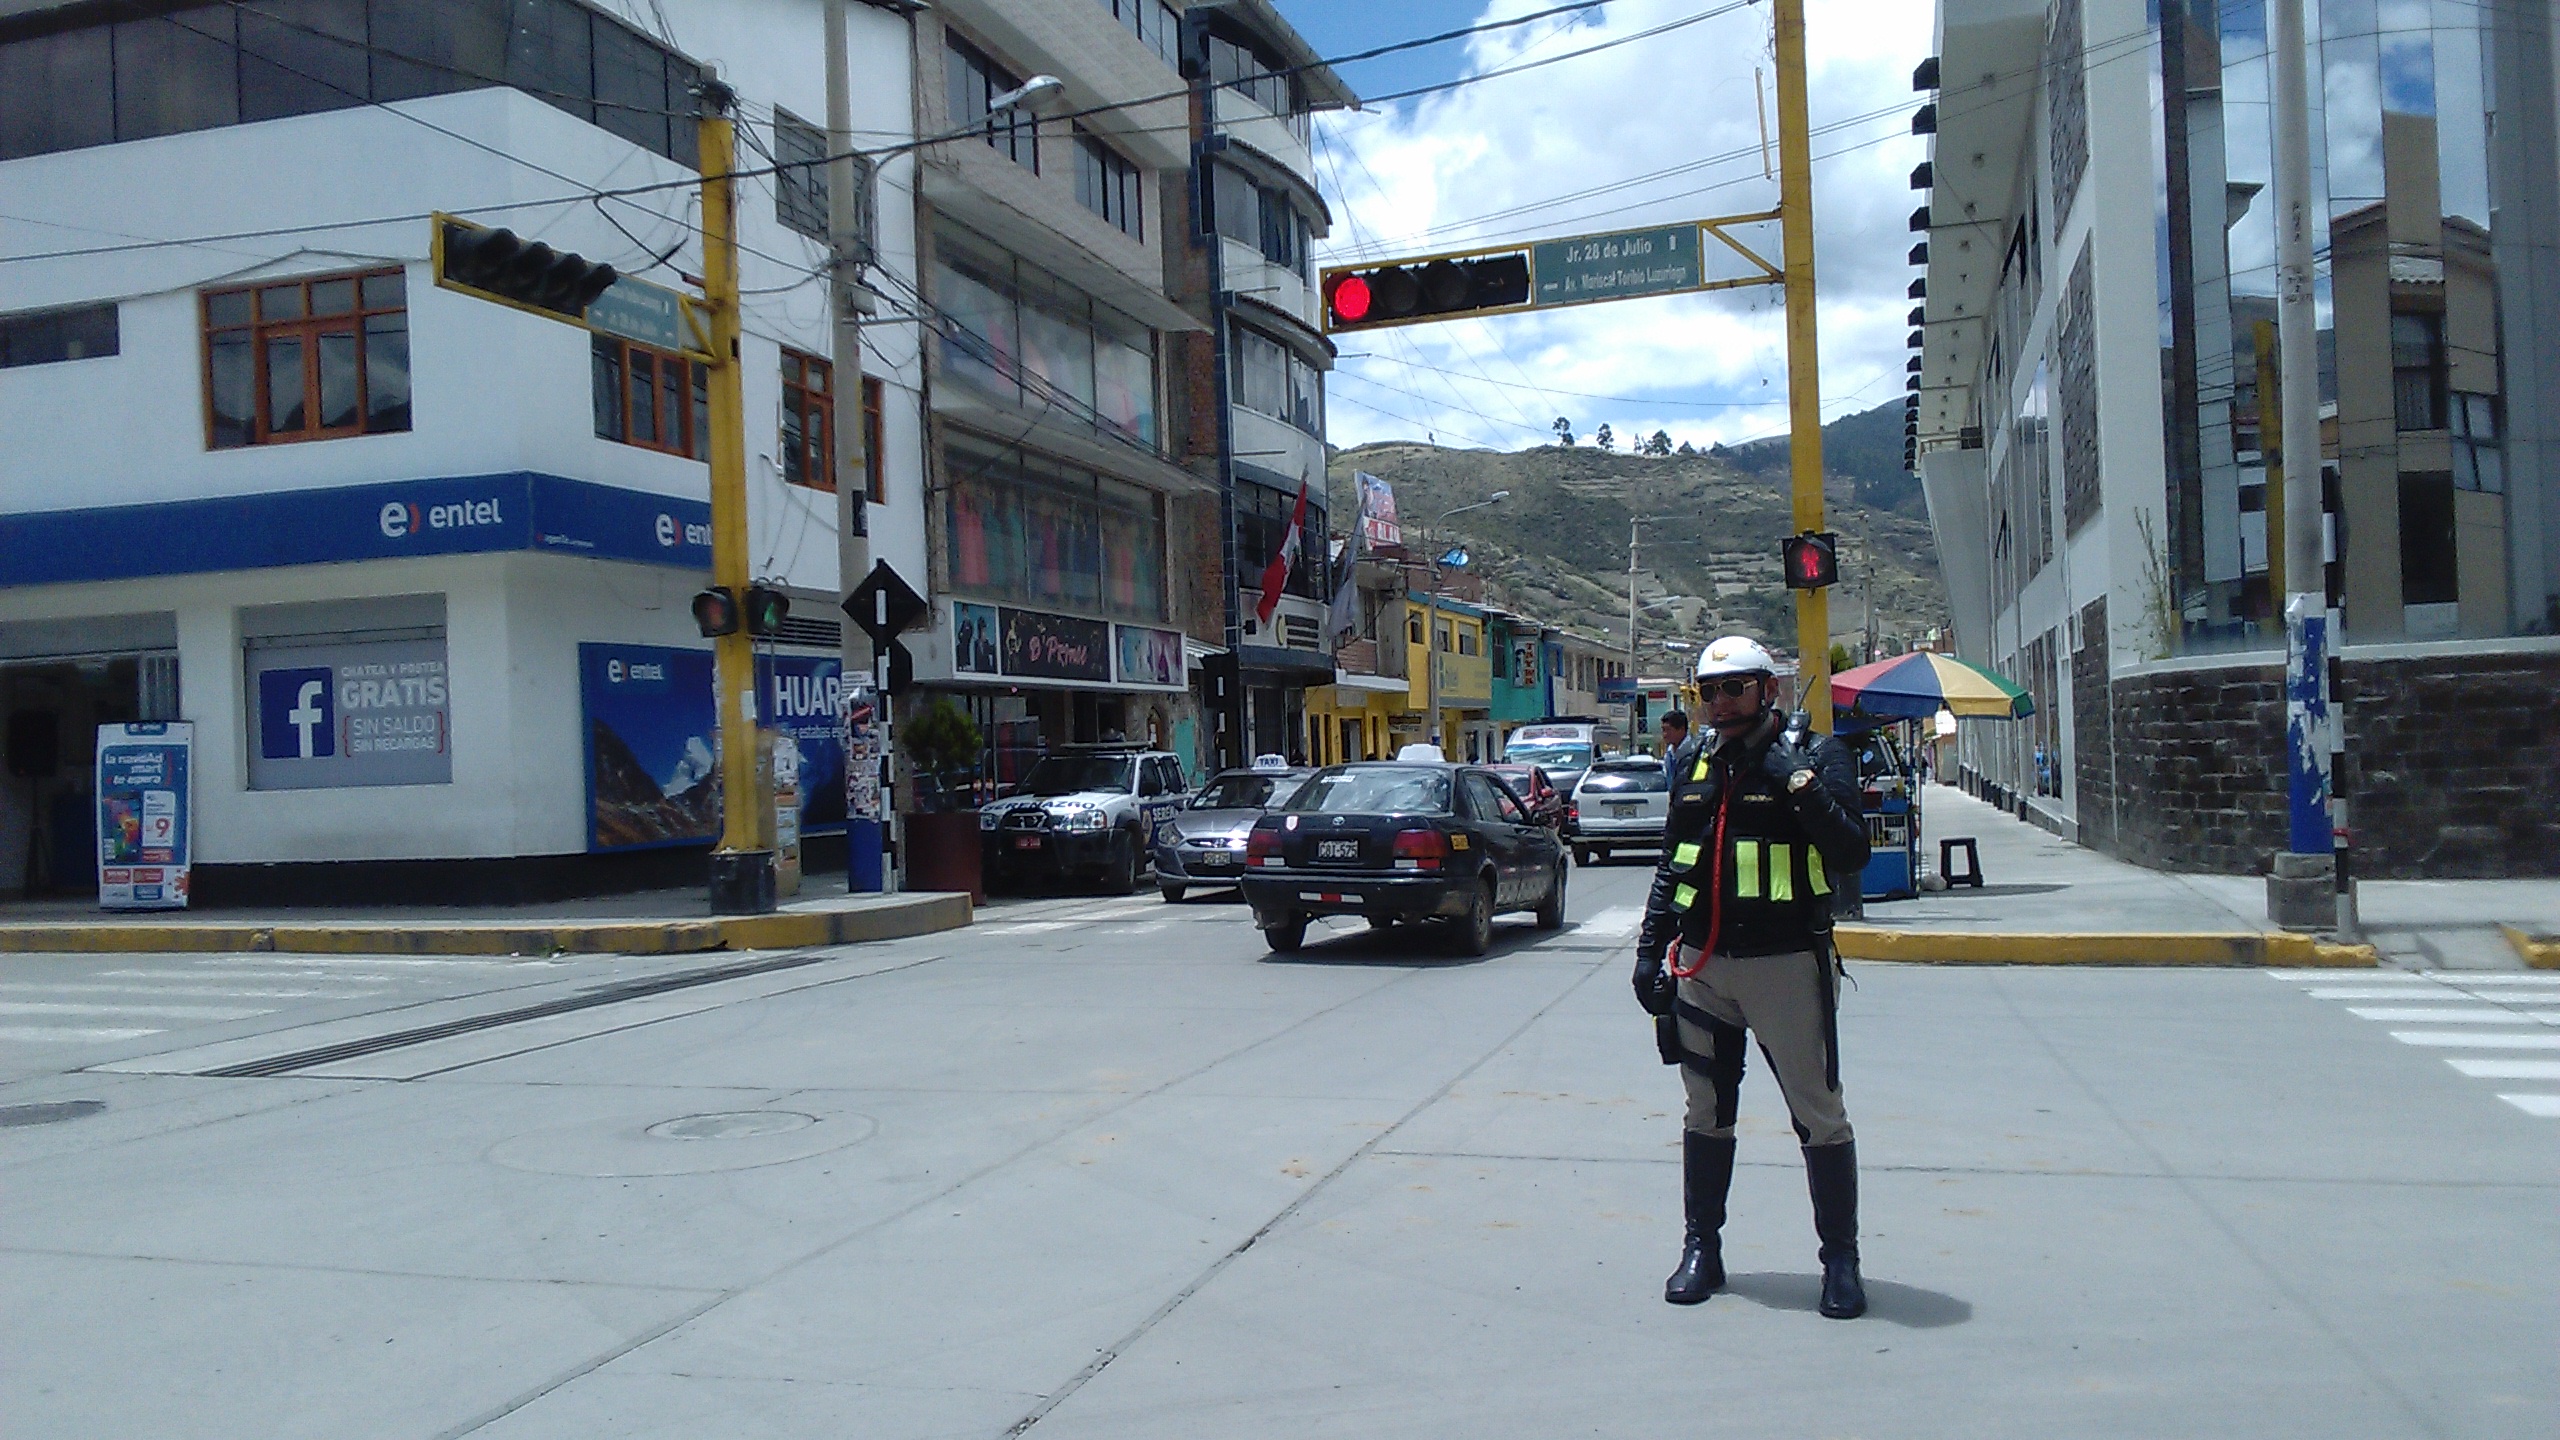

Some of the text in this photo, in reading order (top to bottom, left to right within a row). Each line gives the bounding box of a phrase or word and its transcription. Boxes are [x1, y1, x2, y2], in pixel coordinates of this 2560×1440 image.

[1566, 238, 1652, 263] Jr. 28 de Julio
[428, 498, 503, 529] entel
[341, 662, 444, 677] CHATEA Y POSTEA
[630, 663, 664, 682] entel
[341, 677, 447, 709] GRATIS
[353, 715, 435, 736] SIN SALDO
[353, 737, 435, 752] SIN RECARGAS
[1259, 757, 1279, 766] TAXI
[155, 818, 170, 837] 9
